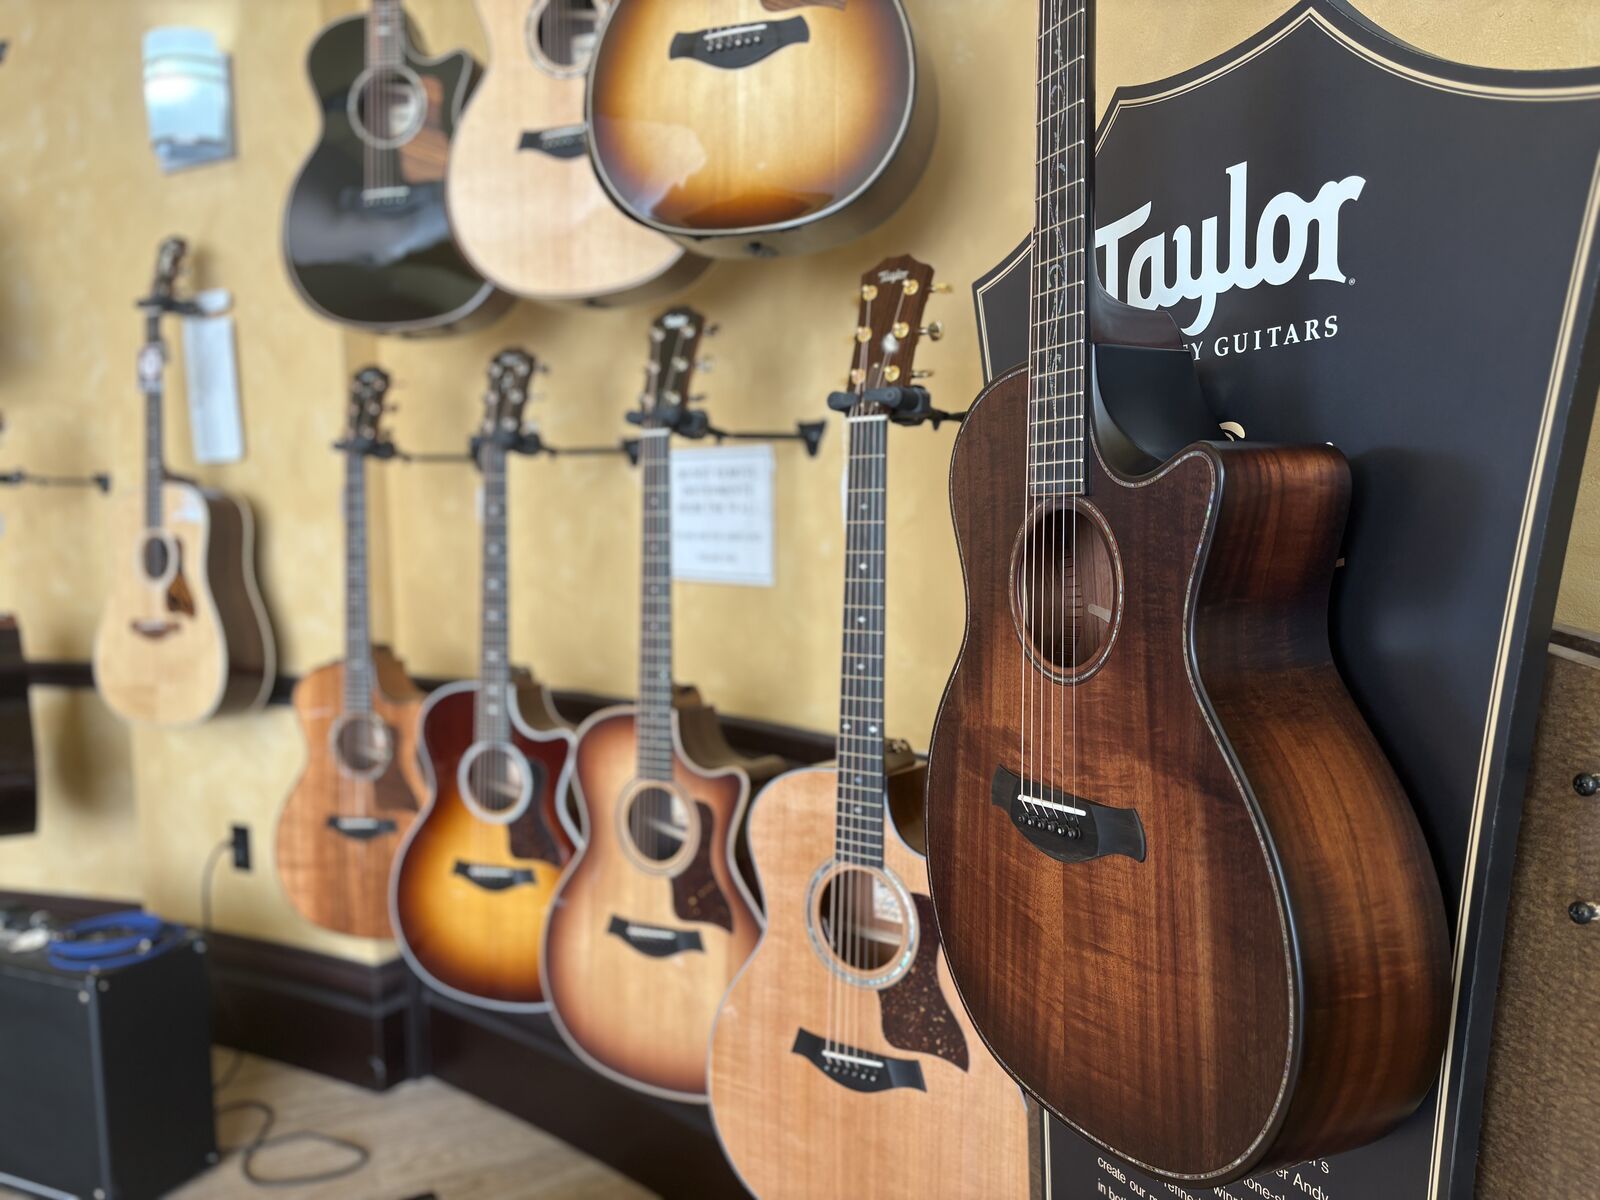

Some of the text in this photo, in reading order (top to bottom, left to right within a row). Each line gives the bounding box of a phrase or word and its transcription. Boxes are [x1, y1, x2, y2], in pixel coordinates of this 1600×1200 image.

[1094, 161, 1367, 336] Taylor
[1213, 315, 1339, 357] GUITARS
[1097, 1157, 1126, 1184] create
[1129, 1180, 1146, 1198] our
[1097, 1177, 1106, 1195] in
